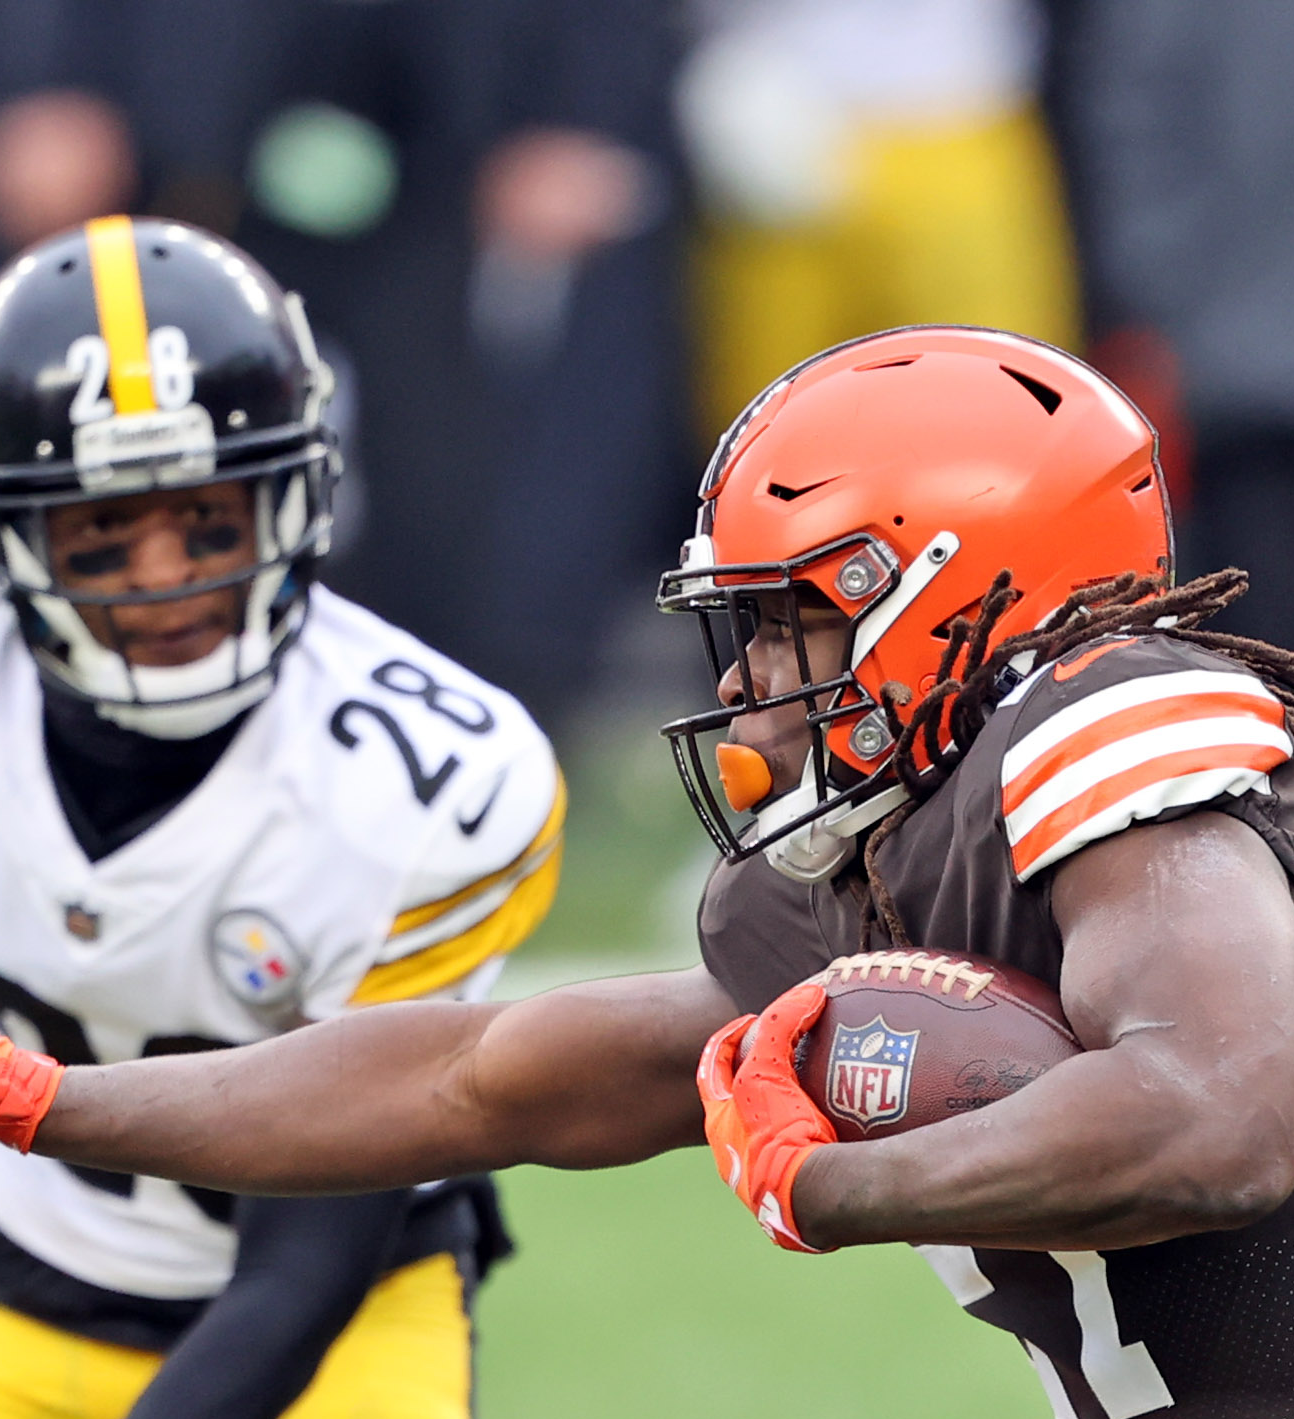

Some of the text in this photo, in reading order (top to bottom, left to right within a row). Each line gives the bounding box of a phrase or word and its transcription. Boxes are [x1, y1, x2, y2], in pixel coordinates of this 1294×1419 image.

[65, 325, 195, 426] 28
[331, 659, 495, 808] 28
[835, 1064, 898, 1117] NFL
